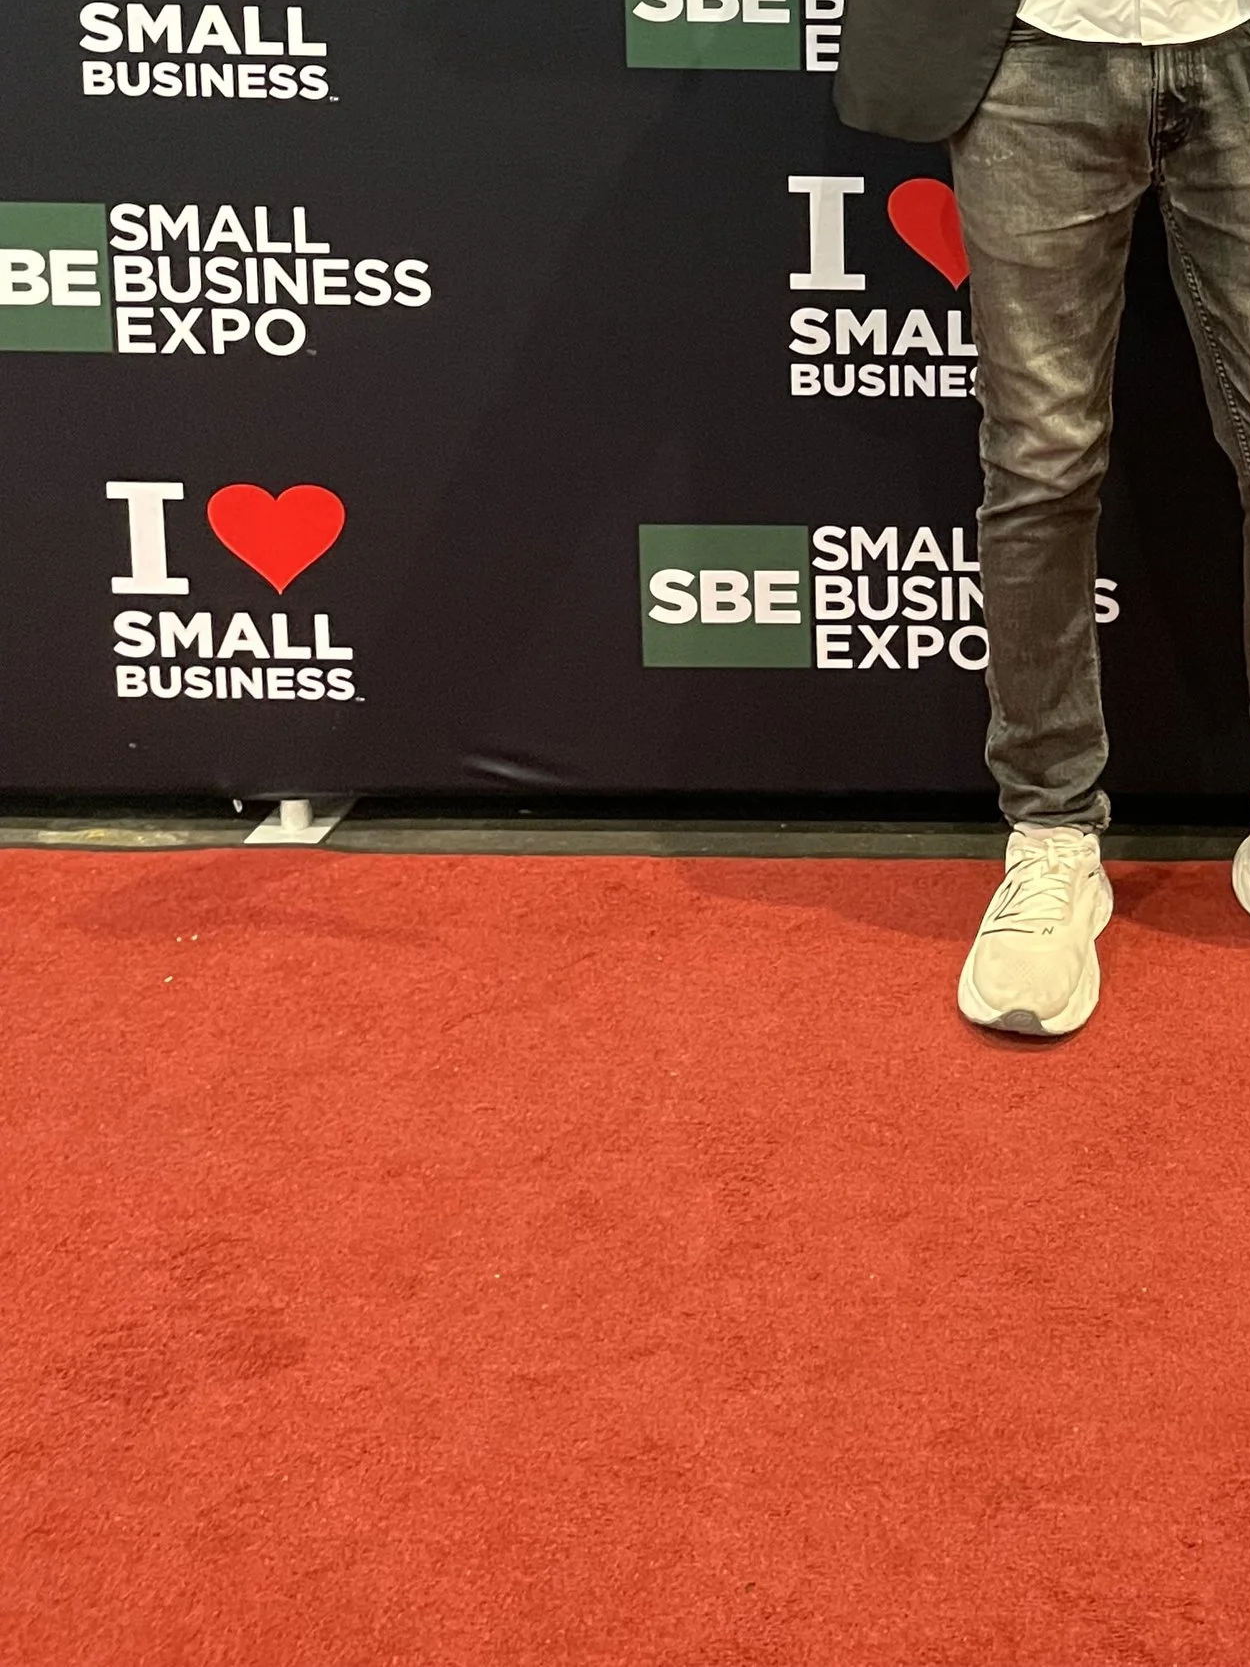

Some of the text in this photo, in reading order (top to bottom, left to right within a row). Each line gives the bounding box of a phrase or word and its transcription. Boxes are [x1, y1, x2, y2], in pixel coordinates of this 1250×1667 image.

[80, 2, 326, 56] SMALL
[83, 61, 328, 99] BUSINESS
[110, 203, 330, 253] SMALL
[788, 176, 865, 290] I
[0, 249, 101, 306] BE
[114, 256, 431, 306] BUSINESS
[116, 307, 306, 356] EXPO
[789, 308, 978, 356] SMAL
[791, 364, 977, 397] BUSINE
[106, 482, 189, 594] I
[812, 526, 980, 571] SMAL
[649, 569, 801, 624] SBE
[815, 576, 1120, 624] BUSINS
[114, 611, 353, 660] SMALL
[816, 625, 989, 670] EXPO
[116, 665, 355, 700] BUSINESS
